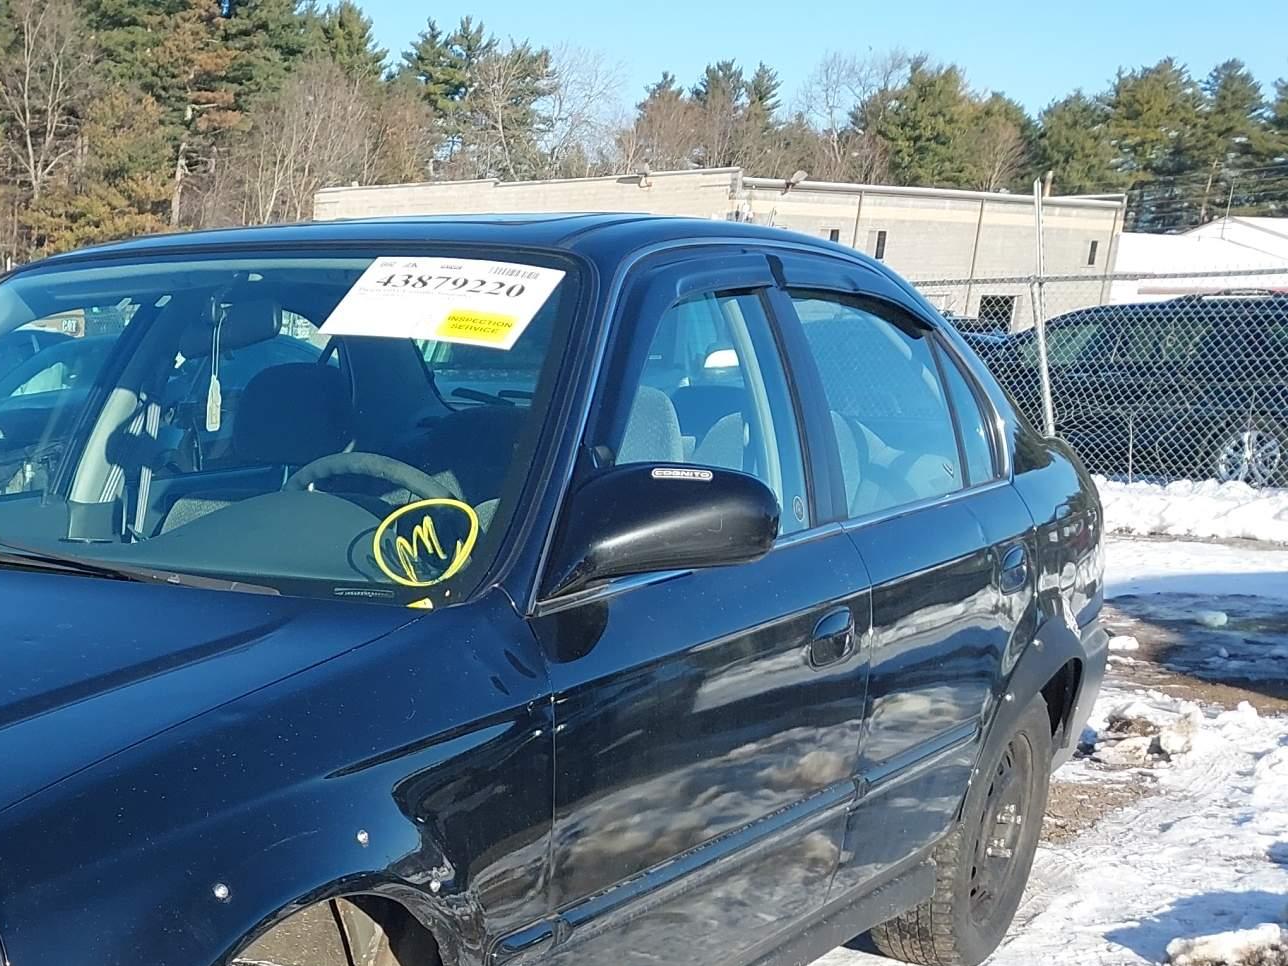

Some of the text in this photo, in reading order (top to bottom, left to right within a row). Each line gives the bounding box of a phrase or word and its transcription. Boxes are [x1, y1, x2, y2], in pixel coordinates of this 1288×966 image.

[376, 274, 525, 297] 43879220
[448, 315, 513, 328] INSPECTION
[450, 323, 500, 335] SERVICE
